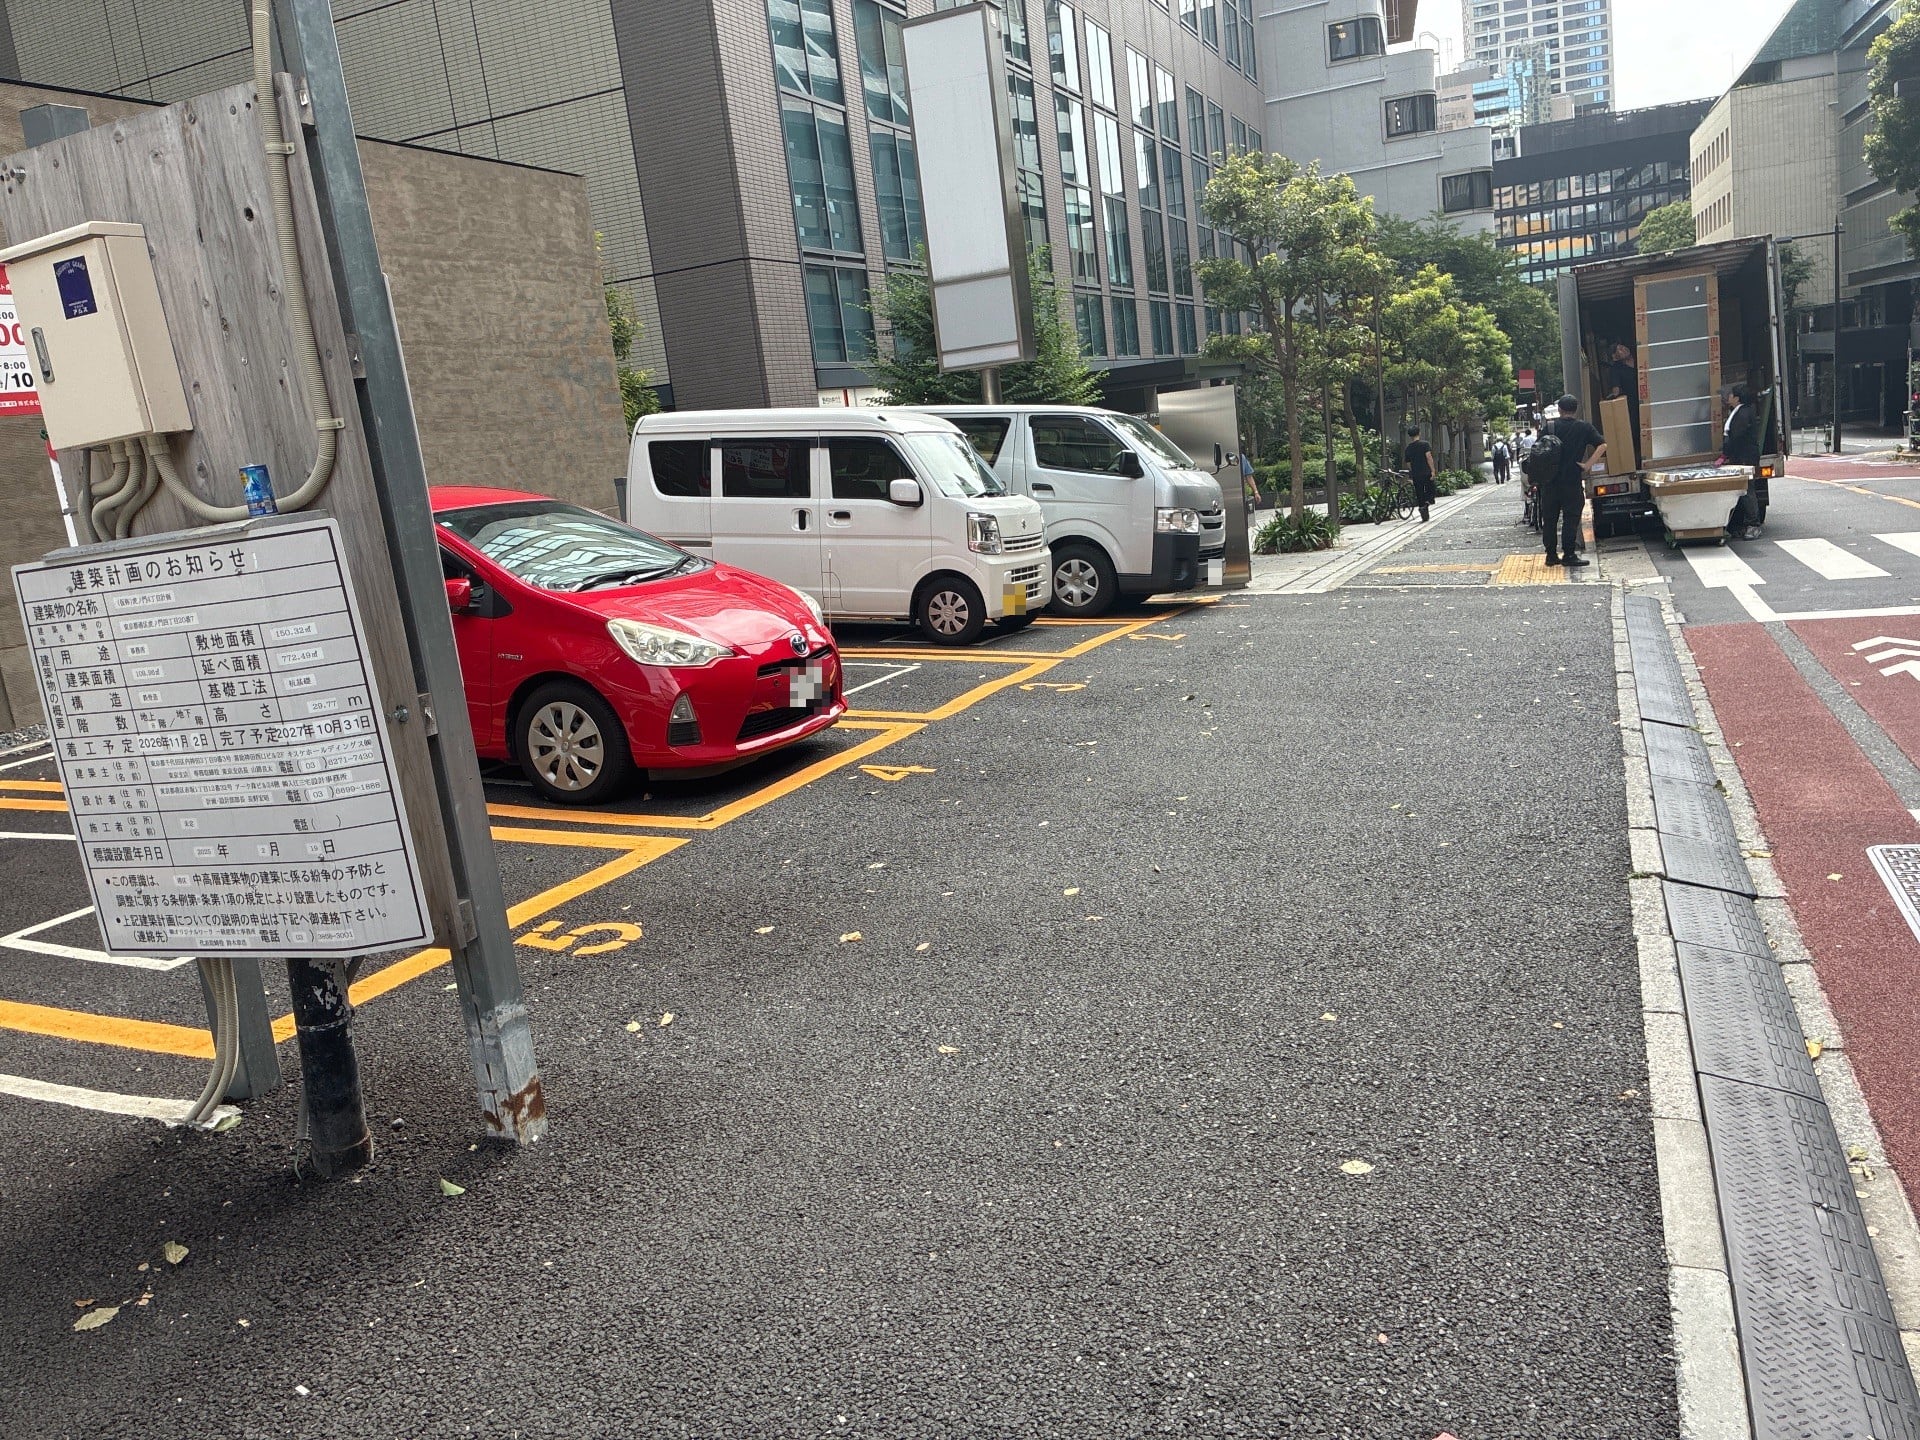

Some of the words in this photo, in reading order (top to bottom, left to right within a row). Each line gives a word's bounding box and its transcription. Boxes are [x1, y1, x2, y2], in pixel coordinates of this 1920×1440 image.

[70, 548, 245, 590] 建築計画のお知らせ
[33, 599, 99, 621] 建築物の名称
[195, 629, 257, 651] 敷地面積
[1127, 633, 1187, 641] 2
[200, 654, 262, 675] 延べ面積
[65, 669, 117, 688] 建築面積
[1018, 682, 1087, 693] 3
[39, 654, 66, 730] 建築物の概要
[207, 679, 268, 699] 基礎工法
[219, 727, 279, 746] 完了予定
[65, 738, 134, 757] 着工予定
[858, 764, 936, 781] 4
[93, 847, 164, 862] 標識設置年月日
[115, 882, 396, 907] 調整に関する条例第条第1項の規定により設置したものです。
[514, 919, 643, 955] 5
